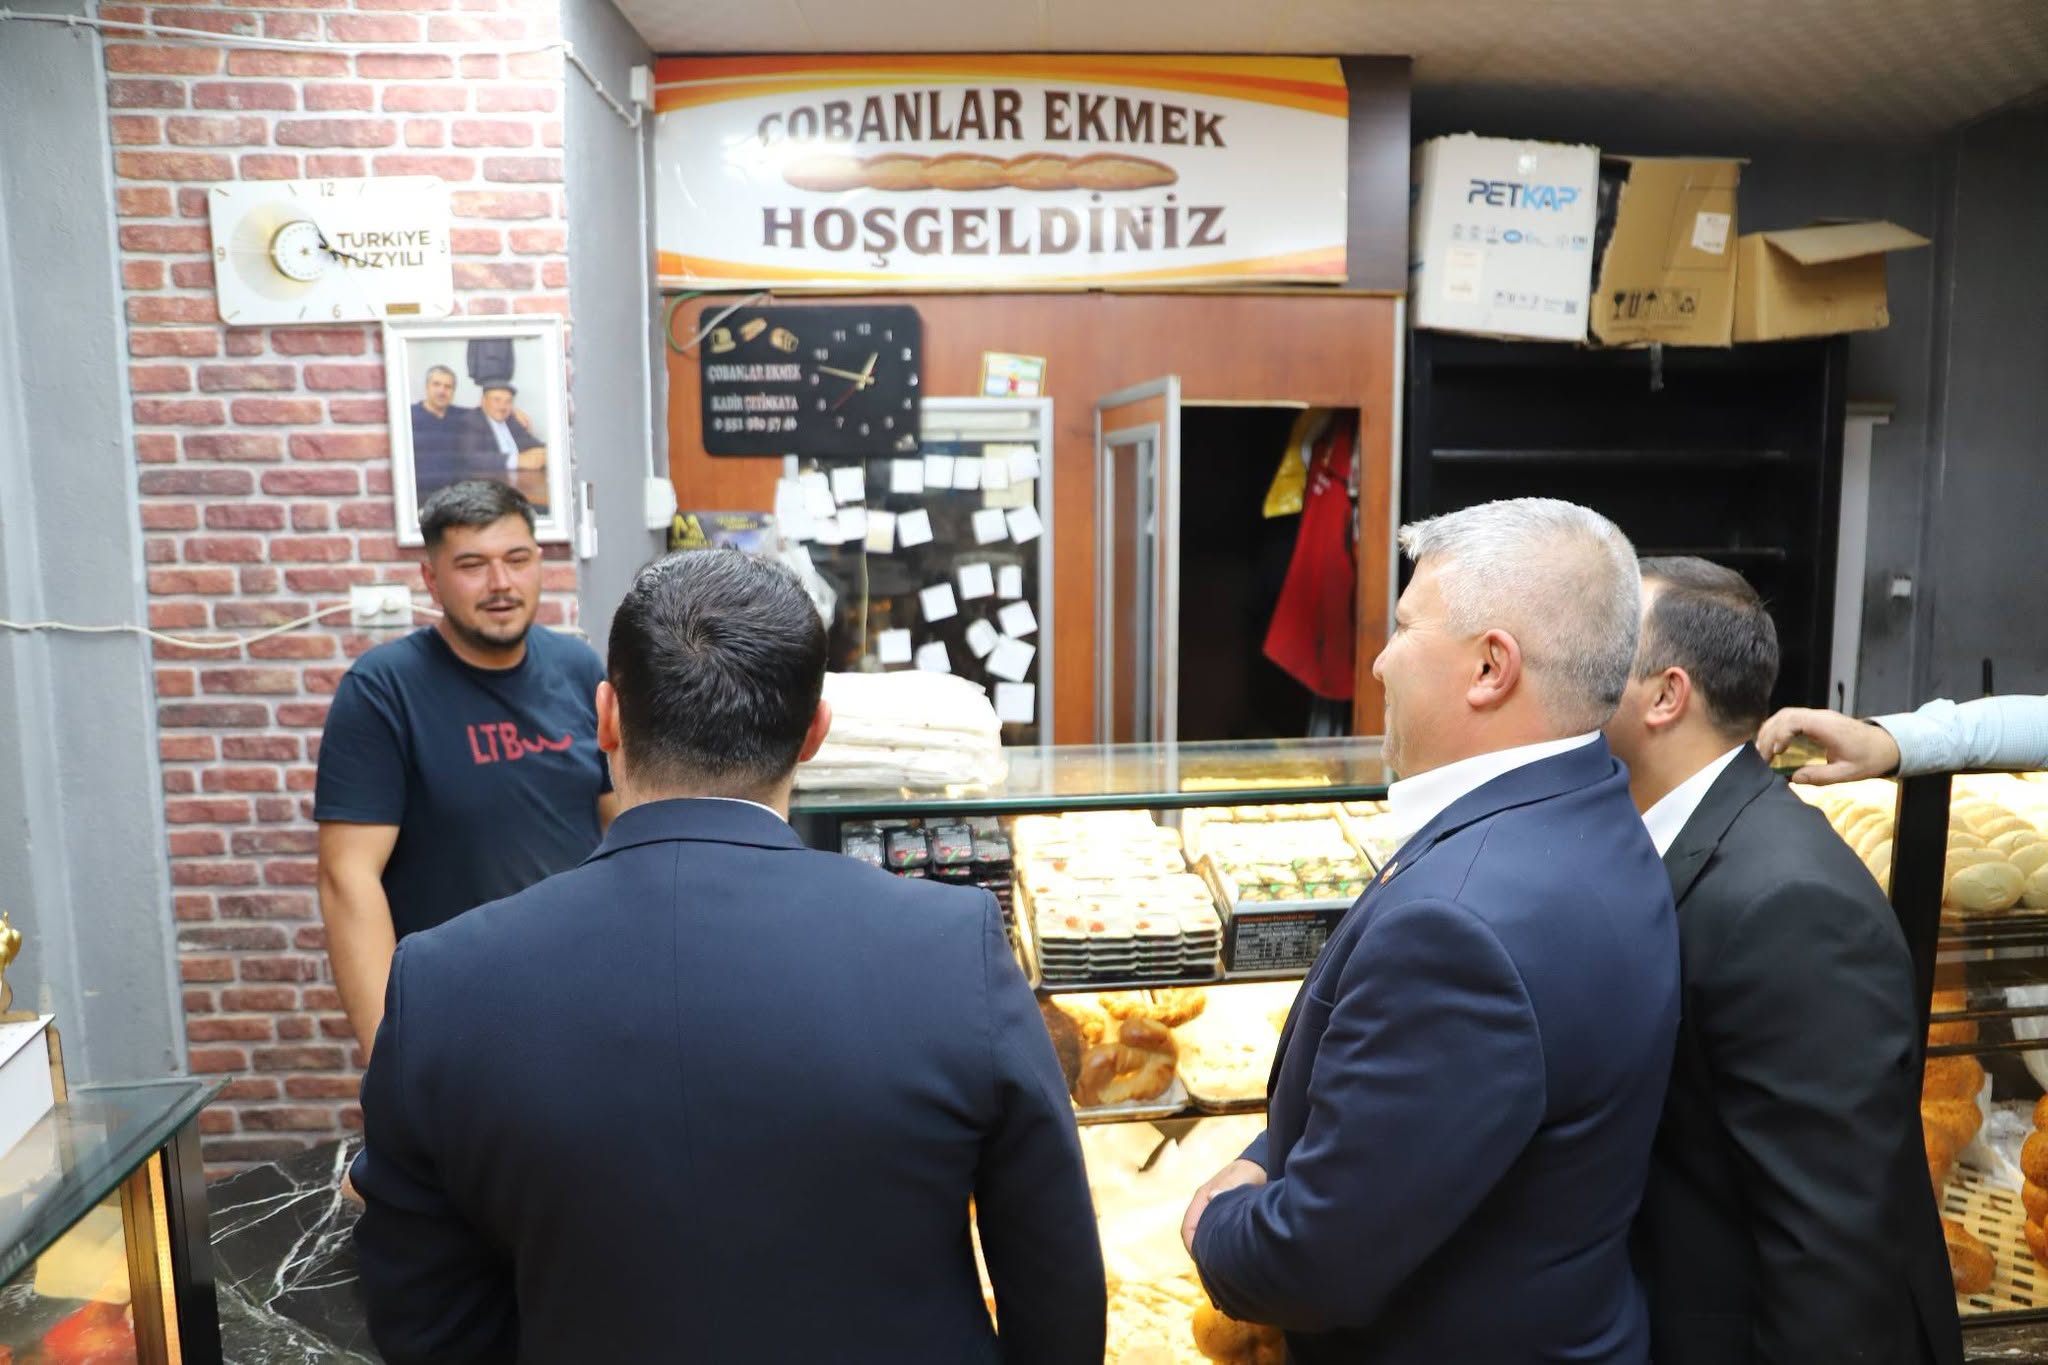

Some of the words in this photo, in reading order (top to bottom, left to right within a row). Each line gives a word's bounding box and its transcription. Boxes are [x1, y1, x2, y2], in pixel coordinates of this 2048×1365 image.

[1044, 91, 1227, 148] EKMEK
[320, 182, 335, 197] 12
[1467, 178, 1578, 213] PETKAP
[762, 194, 1227, 268] HOŞGELDİNİZ
[332, 303, 341, 319] 6
[857, 323, 871, 336] 12
[814, 350, 829, 361] 10
[904, 349, 912, 361] 2
[467, 720, 524, 765] LTB
